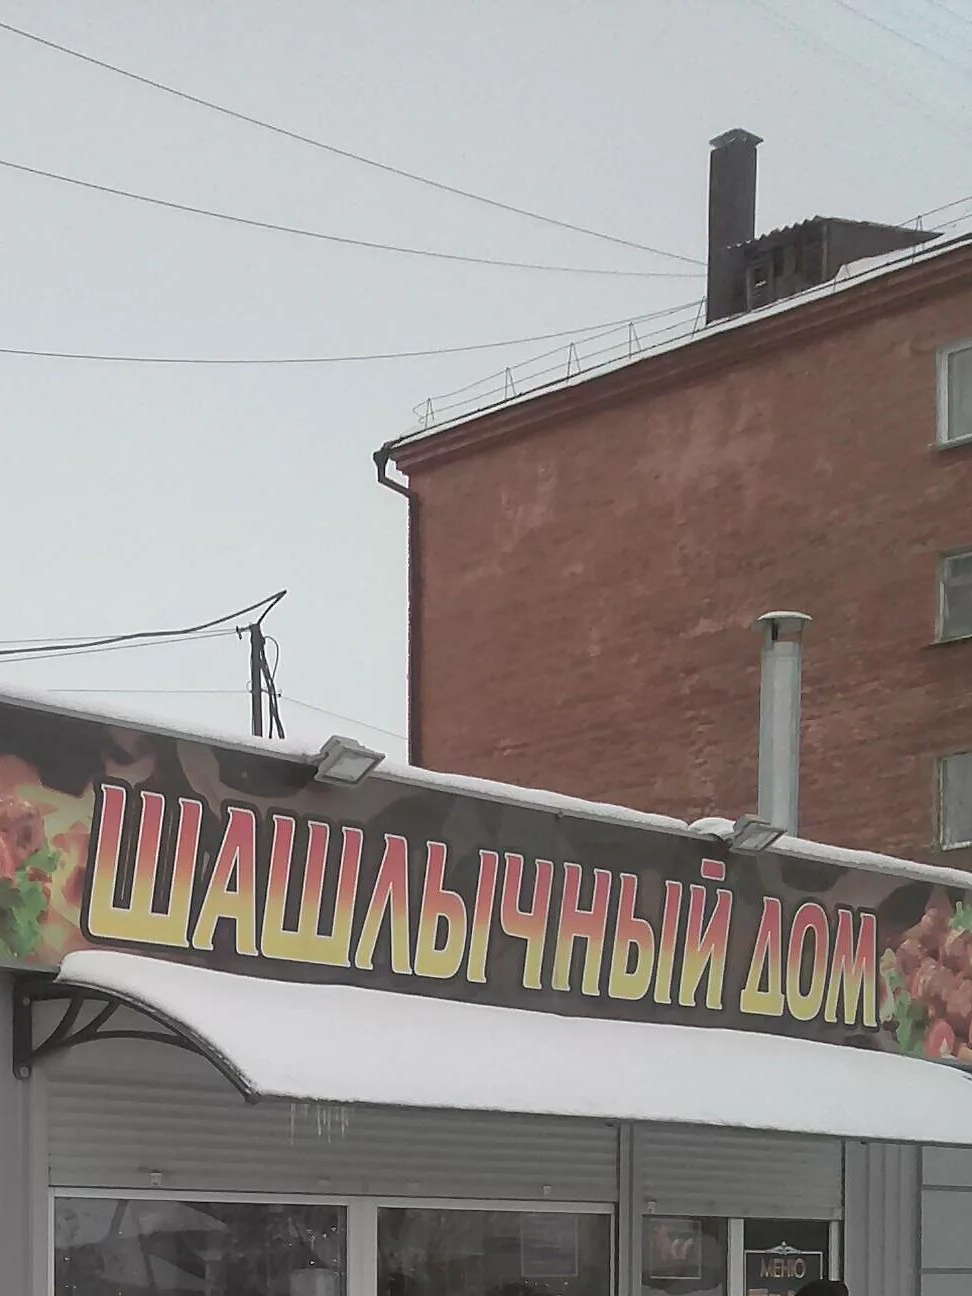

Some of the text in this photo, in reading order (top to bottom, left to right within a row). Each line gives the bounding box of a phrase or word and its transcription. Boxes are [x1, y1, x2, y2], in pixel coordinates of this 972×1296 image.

[87, 783, 880, 1029] ШАШЛЫЧНЫЙ ДОМ
[760, 1257, 806, 1278] МЕНЮ
